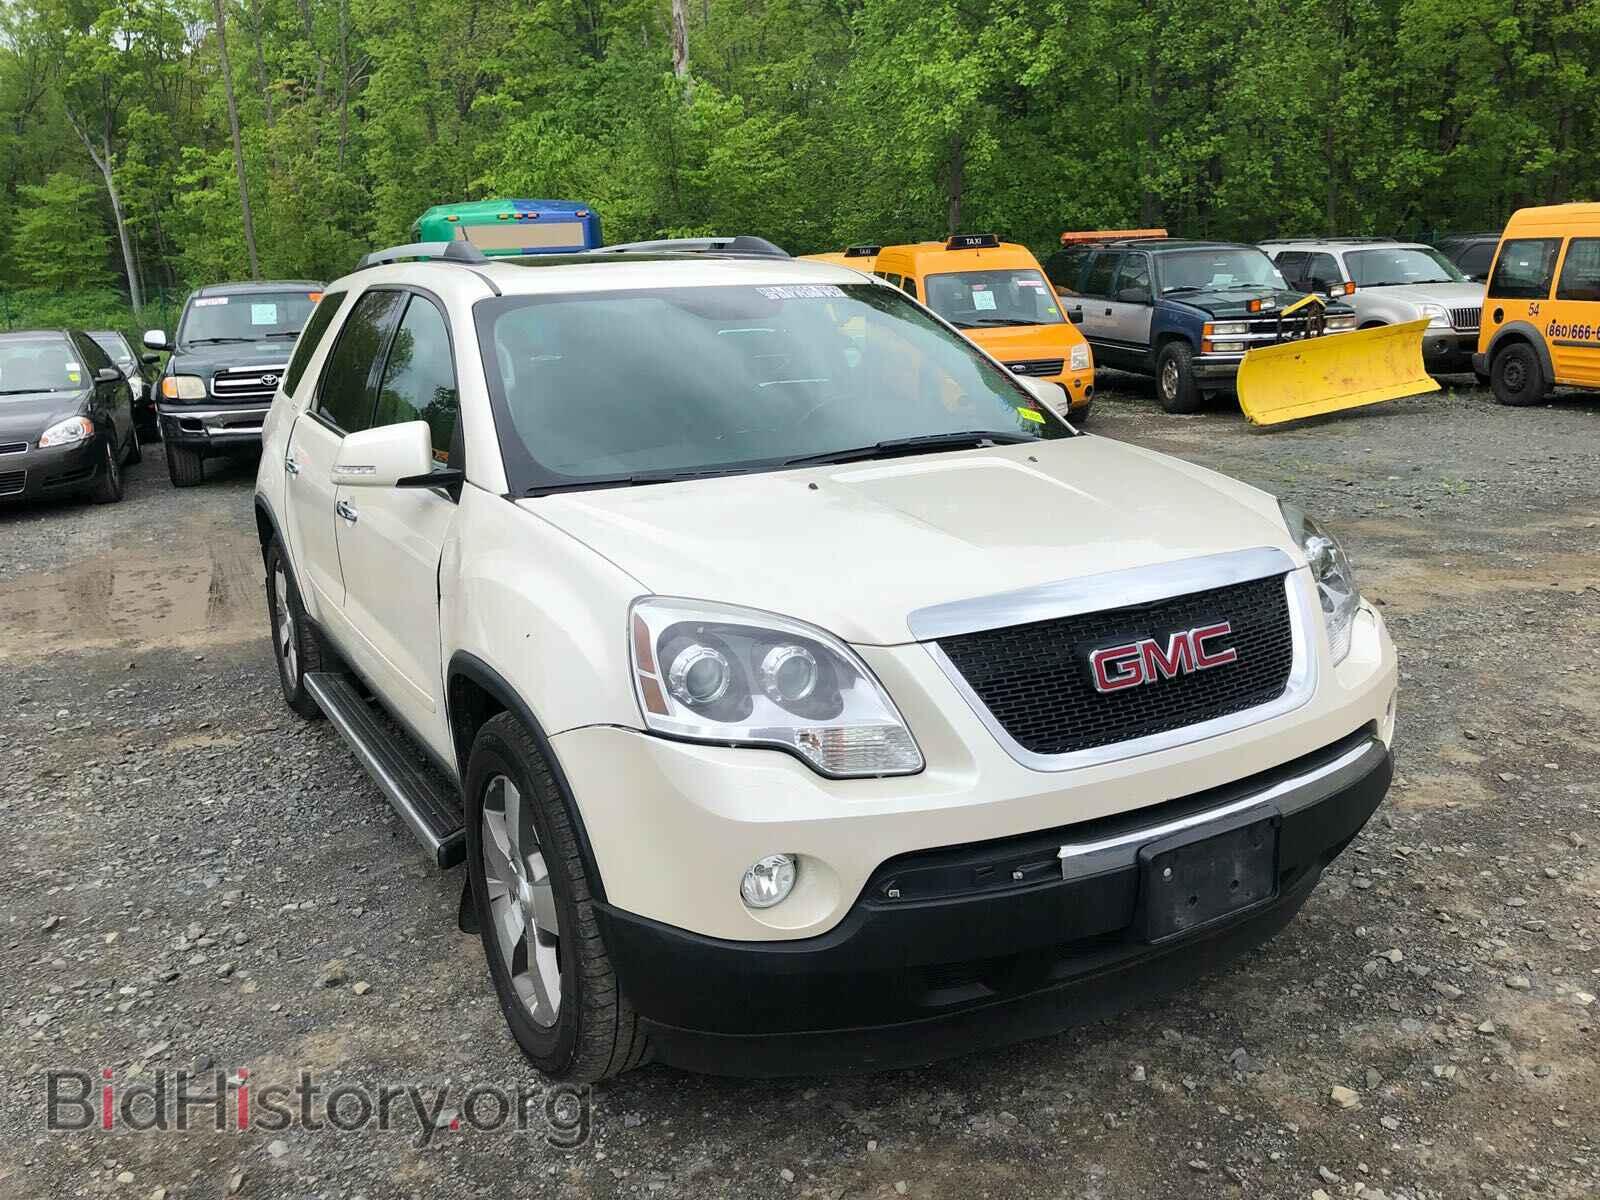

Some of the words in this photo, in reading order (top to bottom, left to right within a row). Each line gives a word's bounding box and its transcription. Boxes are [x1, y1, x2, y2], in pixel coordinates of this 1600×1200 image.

[965, 237, 982, 245] TAXI
[1528, 302, 1540, 316] 54
[1089, 621, 1238, 694] GMC
